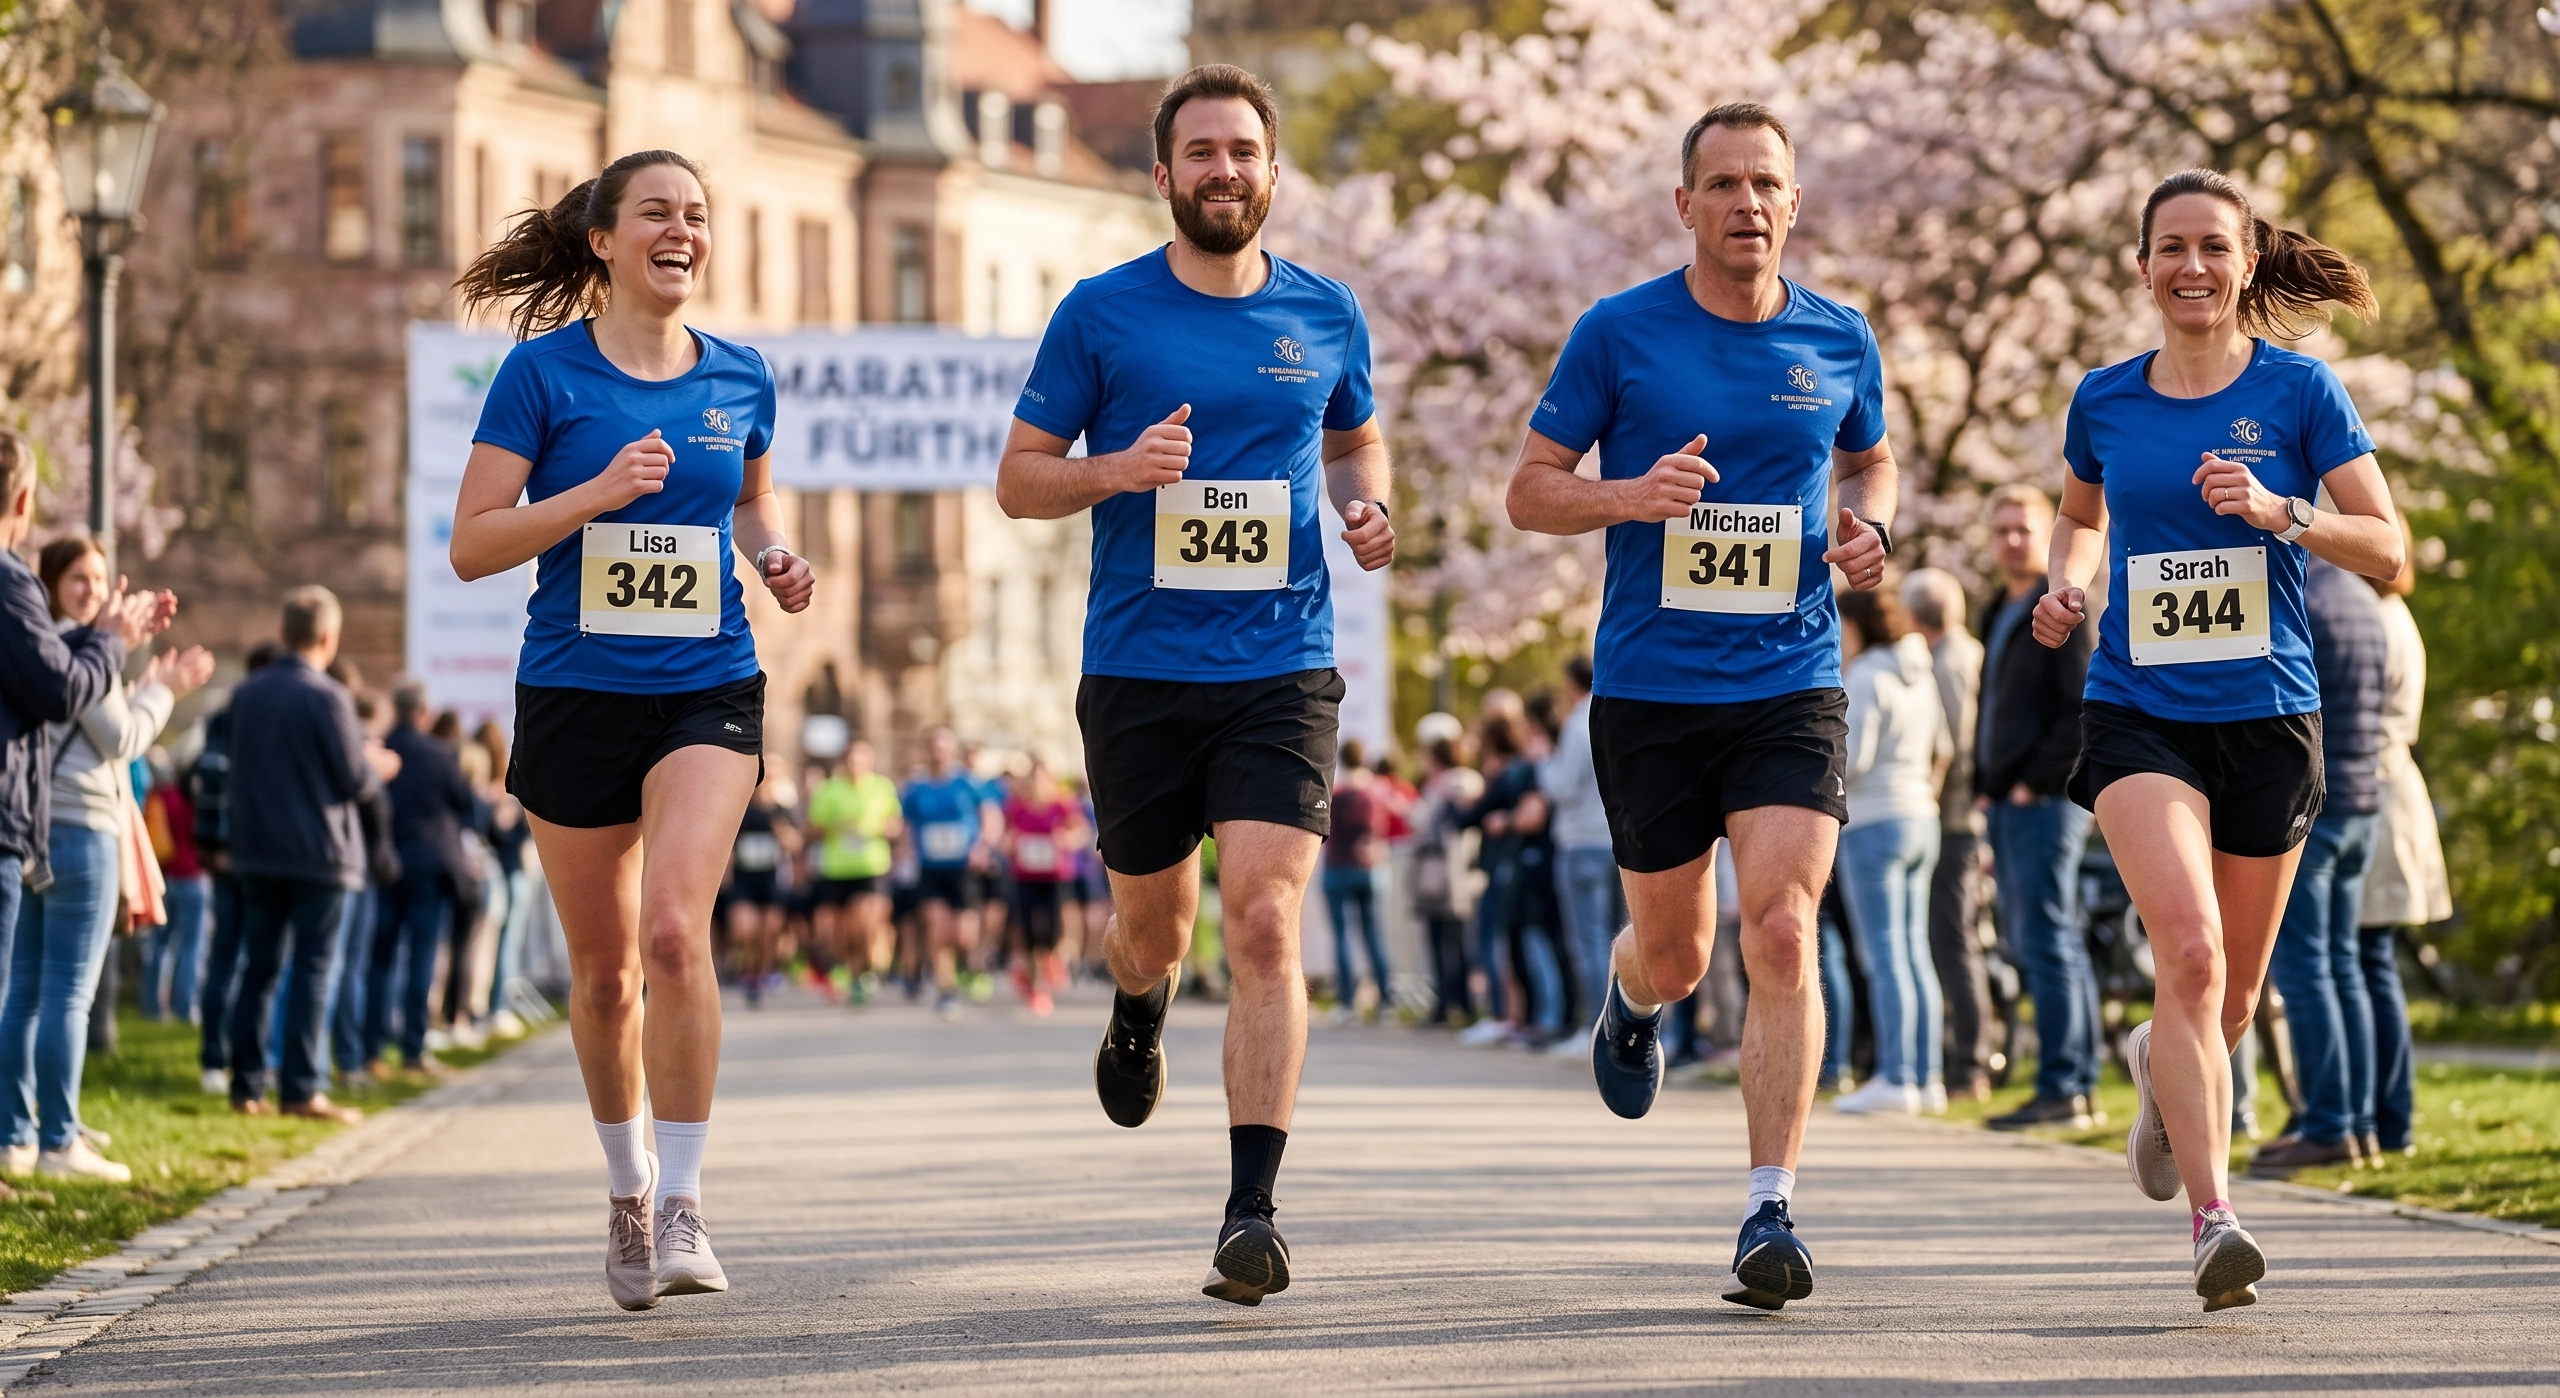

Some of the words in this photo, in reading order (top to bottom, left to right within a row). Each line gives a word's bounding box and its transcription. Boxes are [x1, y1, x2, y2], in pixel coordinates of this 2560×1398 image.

[1203, 486, 1248, 510] Ben
[1689, 508, 1781, 534] Michael
[629, 530, 677, 554] Lisa
[1179, 518, 1269, 564] 343
[1688, 541, 1772, 587] 341
[2159, 554, 2230, 581] Sarah
[606, 561, 698, 609] 342
[2152, 587, 2245, 637] 344
